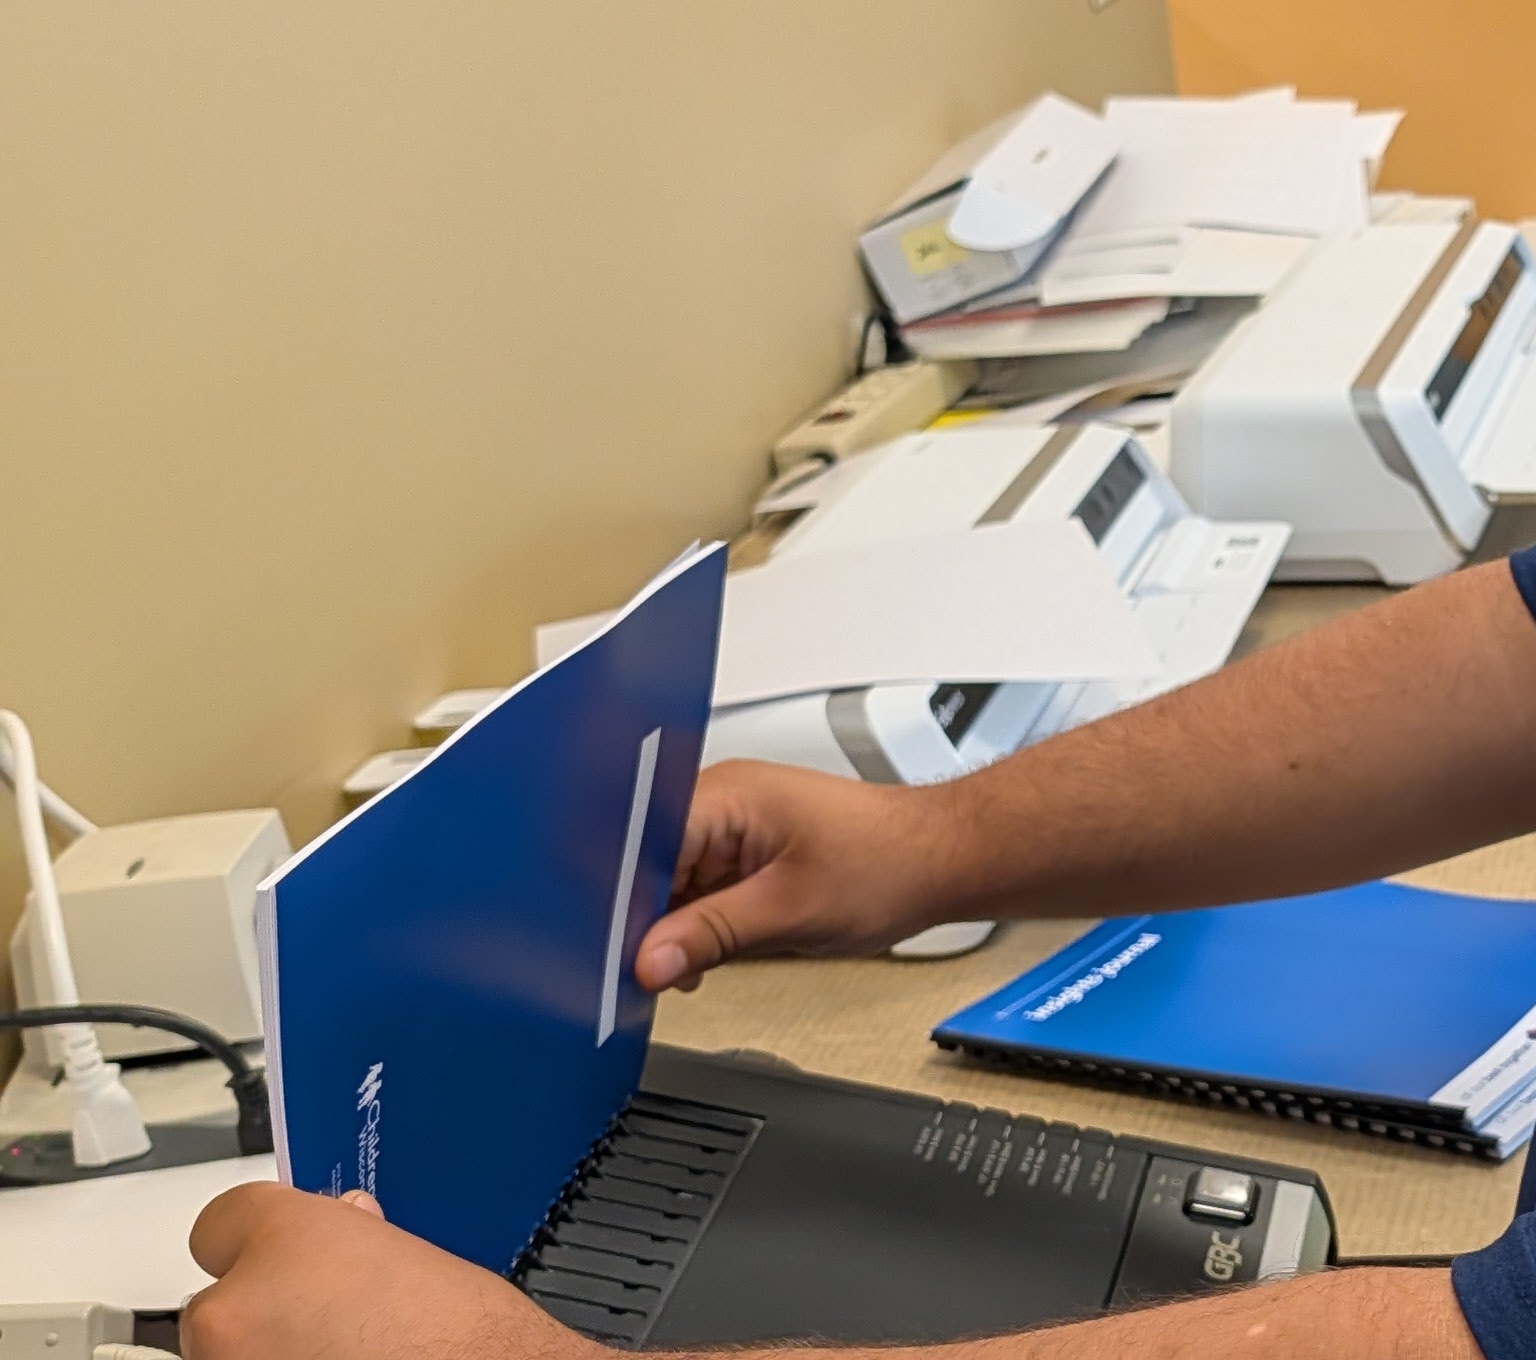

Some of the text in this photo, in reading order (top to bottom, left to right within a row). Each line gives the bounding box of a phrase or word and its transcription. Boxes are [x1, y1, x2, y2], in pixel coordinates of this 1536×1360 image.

[358, 1125, 368, 1190] Wiscon
[368, 1099, 381, 1198] Children
[1203, 1230, 1243, 1281] GBC
